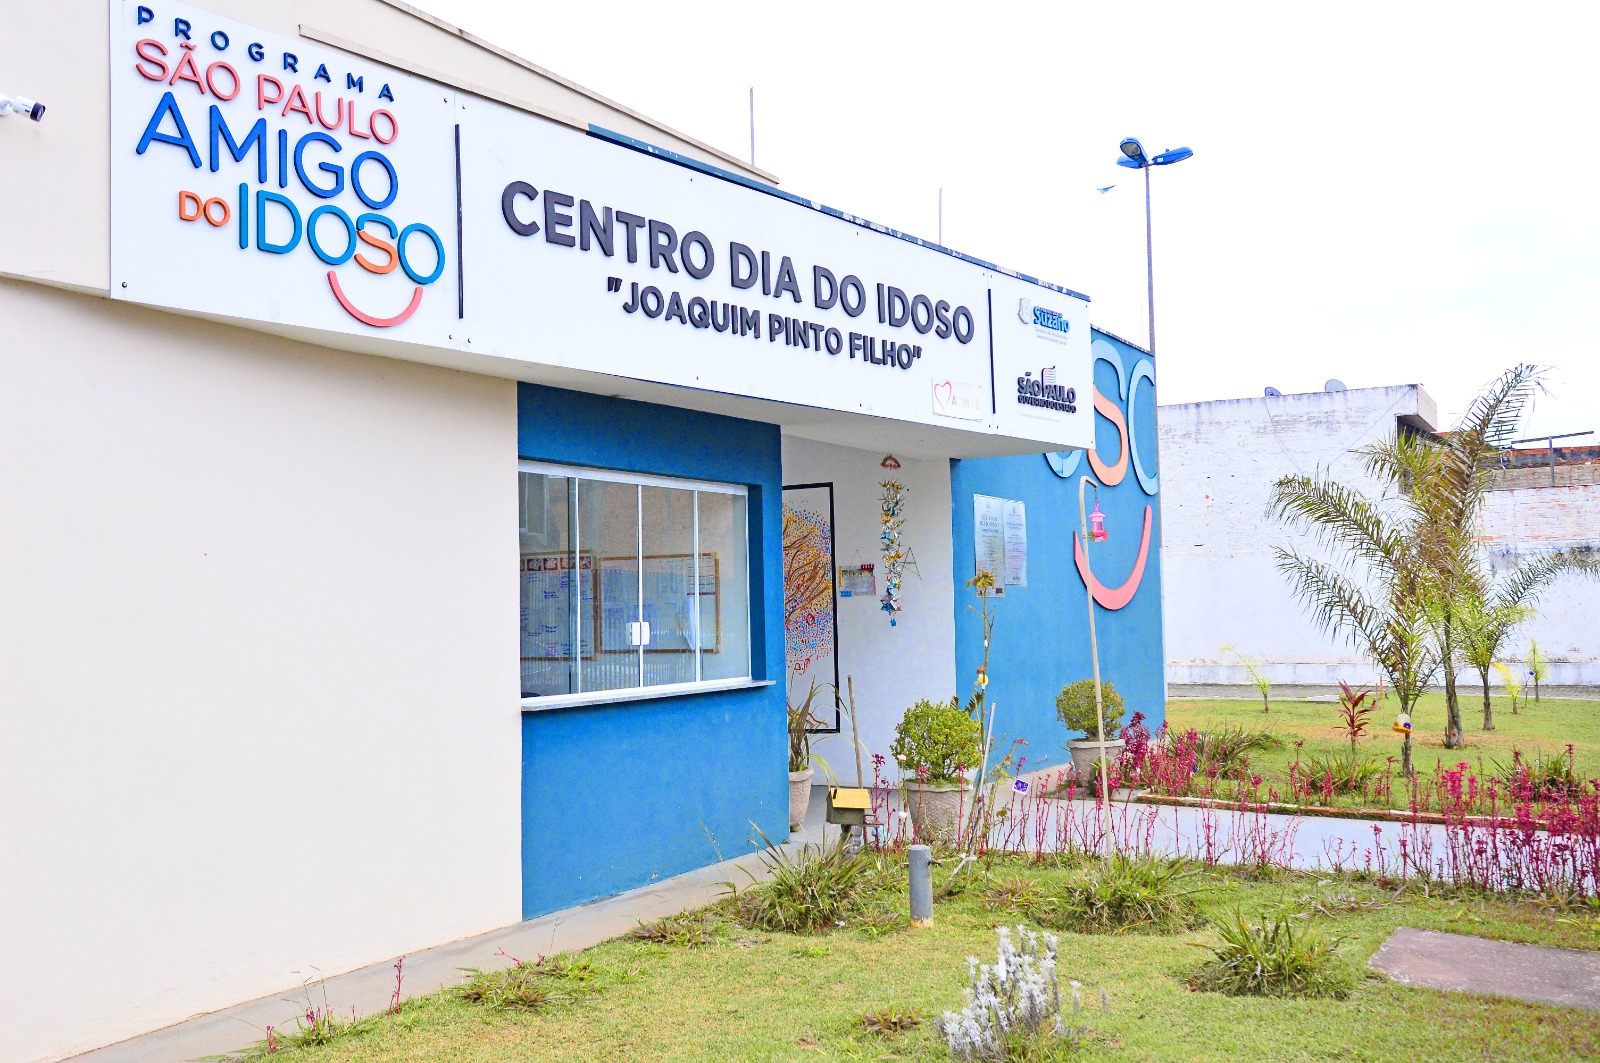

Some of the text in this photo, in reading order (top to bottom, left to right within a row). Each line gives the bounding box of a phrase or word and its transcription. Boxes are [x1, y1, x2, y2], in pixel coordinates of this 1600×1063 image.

[136, 38, 398, 145] SÃO PAULO
[137, 5, 394, 102] PROGRAMA
[136, 91, 399, 210] AMIGO
[178, 182, 446, 285] DO IDOSO
[501, 180, 975, 345] CENTRO DIA DO IDOSO
[769, 314, 843, 356] PINTO
[1033, 306, 1071, 332] Suzano
[1017, 371, 1077, 404] SÃO PAULO
